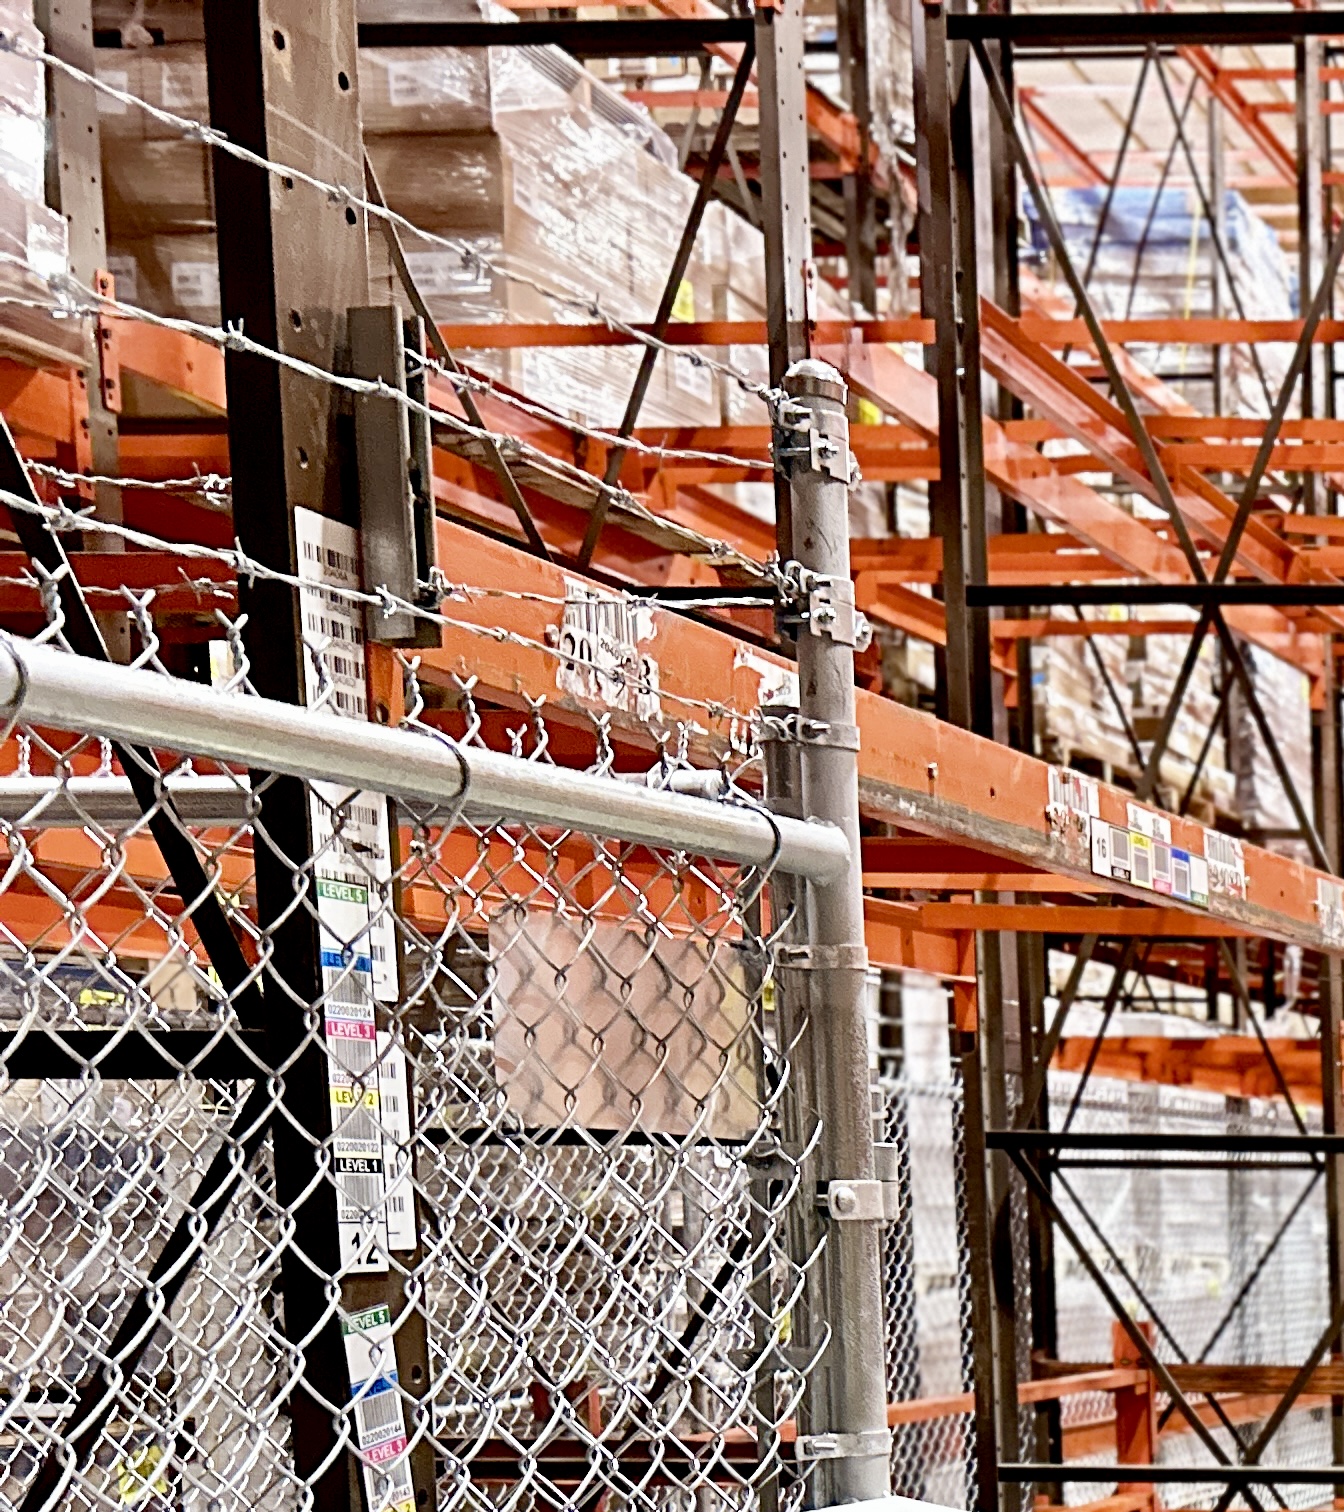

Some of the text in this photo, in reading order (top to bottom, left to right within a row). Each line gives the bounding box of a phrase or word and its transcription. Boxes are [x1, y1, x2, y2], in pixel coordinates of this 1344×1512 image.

[322, 884, 363, 903] LEVEL 5
[331, 1022, 371, 1038] LEVEL 3
[368, 1093, 374, 1105] 2
[340, 1159, 378, 1172] LEVEL 1
[379, 1310, 386, 1324] 5
[366, 1440, 403, 1463] LEVEL 3
